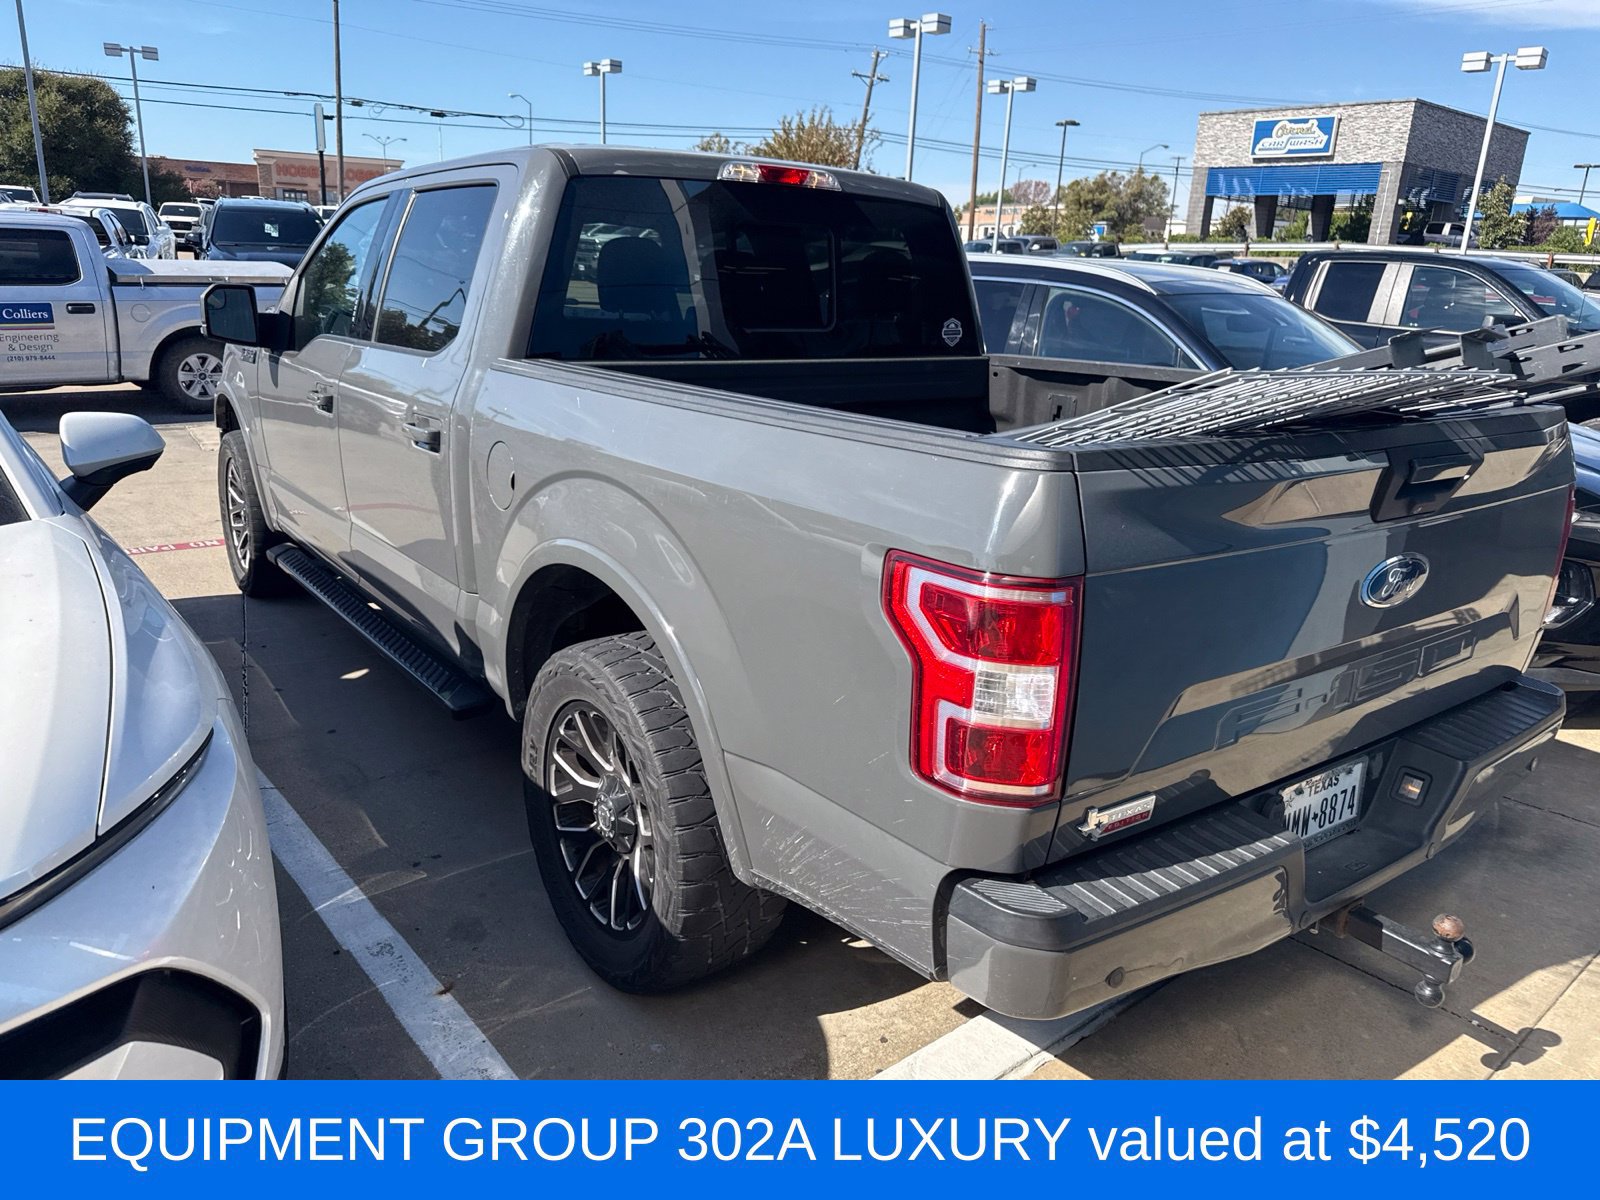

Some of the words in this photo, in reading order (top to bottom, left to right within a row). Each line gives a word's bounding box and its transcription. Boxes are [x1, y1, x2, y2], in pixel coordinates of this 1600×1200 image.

[275, 162, 329, 179] HOBB
[2, 308, 49, 319] Colliers
[0, 332, 60, 343] Engineering
[8, 344, 16, 352] &
[18, 343, 54, 352] Design
[1308, 774, 1341, 797] TEXAS
